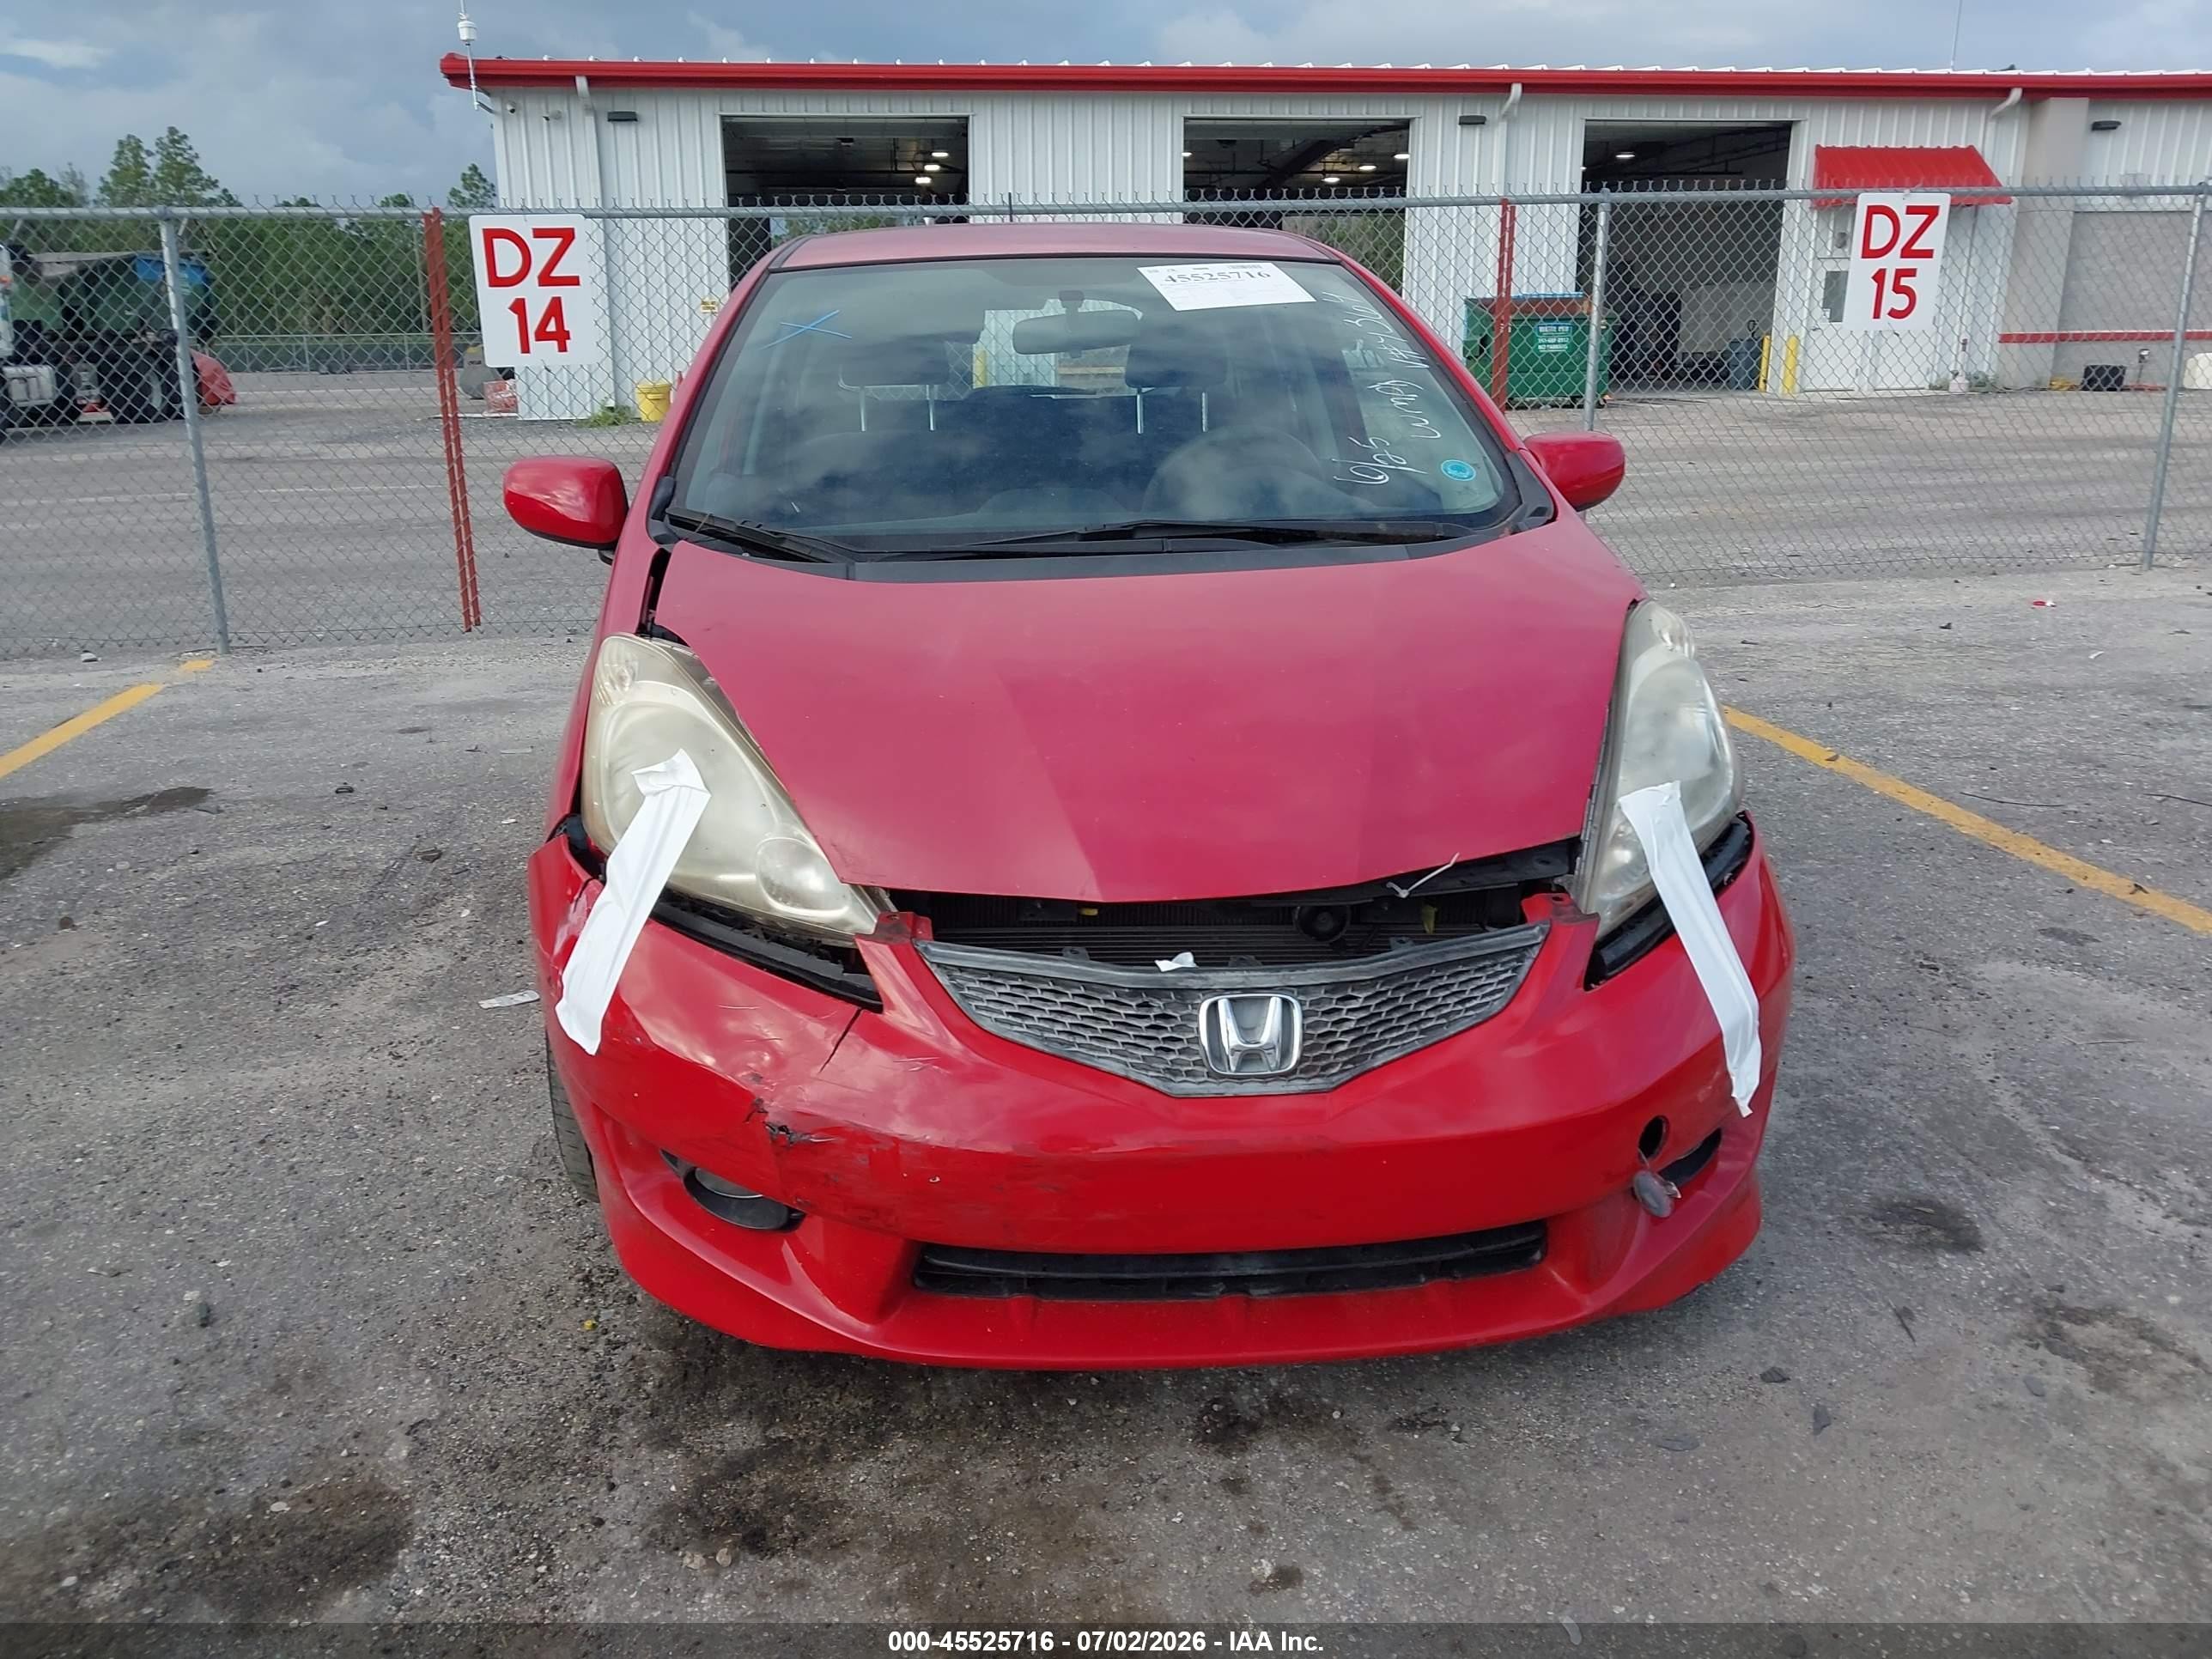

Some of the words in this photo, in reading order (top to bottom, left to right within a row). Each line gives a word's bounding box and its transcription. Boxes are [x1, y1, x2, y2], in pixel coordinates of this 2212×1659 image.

[483, 228, 581, 288] DZ
[1861, 204, 1939, 259] DZ
[1164, 270, 1271, 283] 45525716
[1871, 268, 1917, 319] 15
[509, 296, 572, 354] 14
